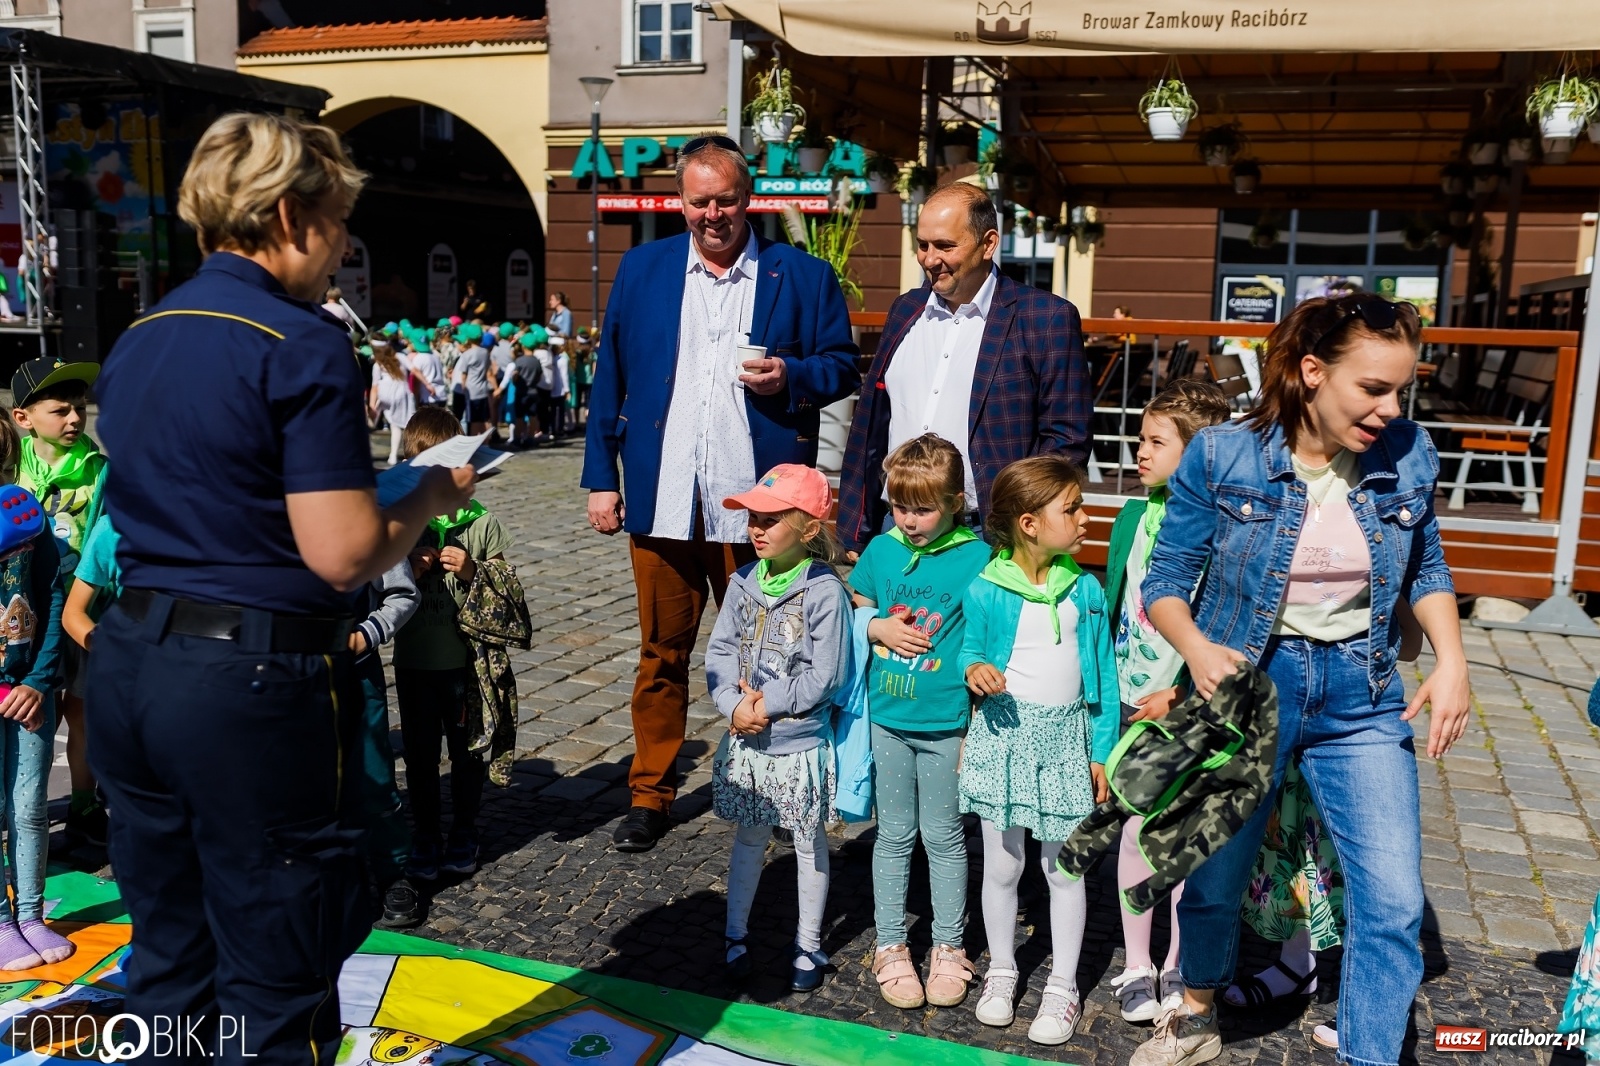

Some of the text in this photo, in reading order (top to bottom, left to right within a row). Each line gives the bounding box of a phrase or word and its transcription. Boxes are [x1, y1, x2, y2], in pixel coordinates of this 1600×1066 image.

[1083, 8, 1308, 31] Browar Zamkowy Racibórz
[761, 180, 796, 191] POD
[597, 198, 638, 209] RYNEK
[640, 198, 655, 209] 12
[1228, 297, 1273, 309] CATERING
[885, 579, 954, 609] have a
